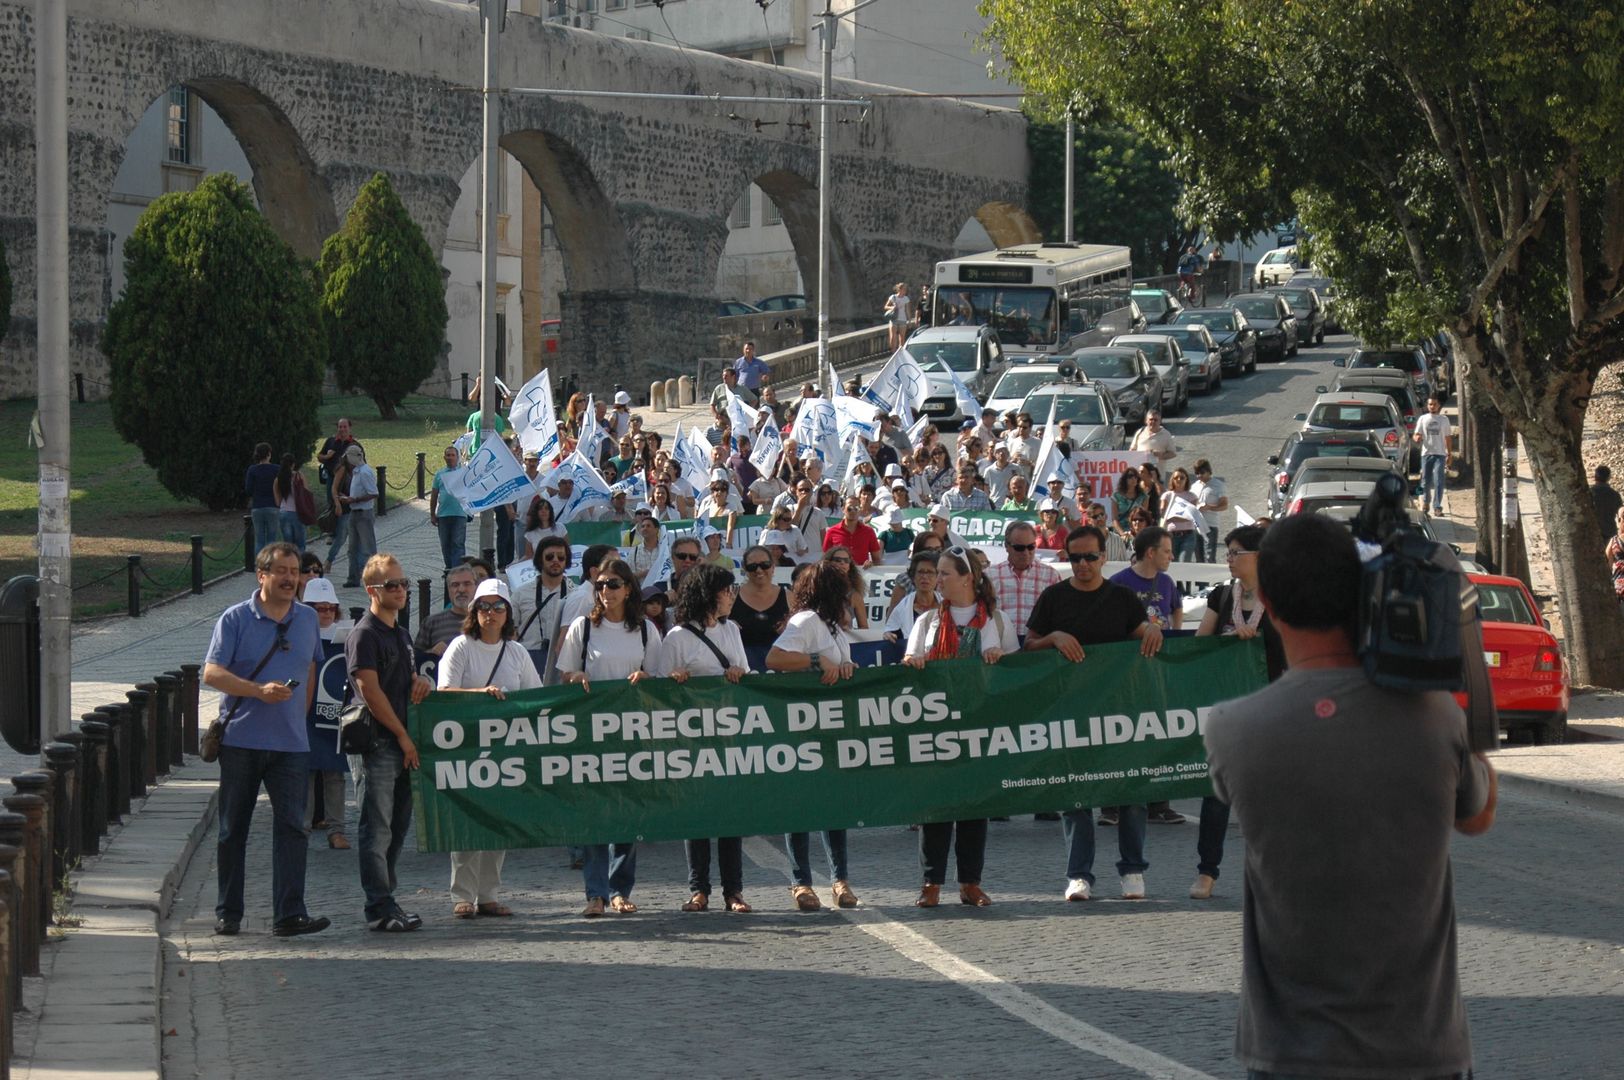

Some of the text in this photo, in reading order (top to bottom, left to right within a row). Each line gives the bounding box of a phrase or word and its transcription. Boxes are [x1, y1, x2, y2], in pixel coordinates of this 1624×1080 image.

[1077, 458, 1129, 474] rivado
[432, 687, 961, 750] O PAÍS PRECISA DE NÓS.
[435, 751, 527, 790] NÓS
[541, 742, 824, 785] PRECISAMOS
[837, 736, 895, 769] DE
[1001, 762, 1209, 789] Sindicato dos Professores da Região Centro
